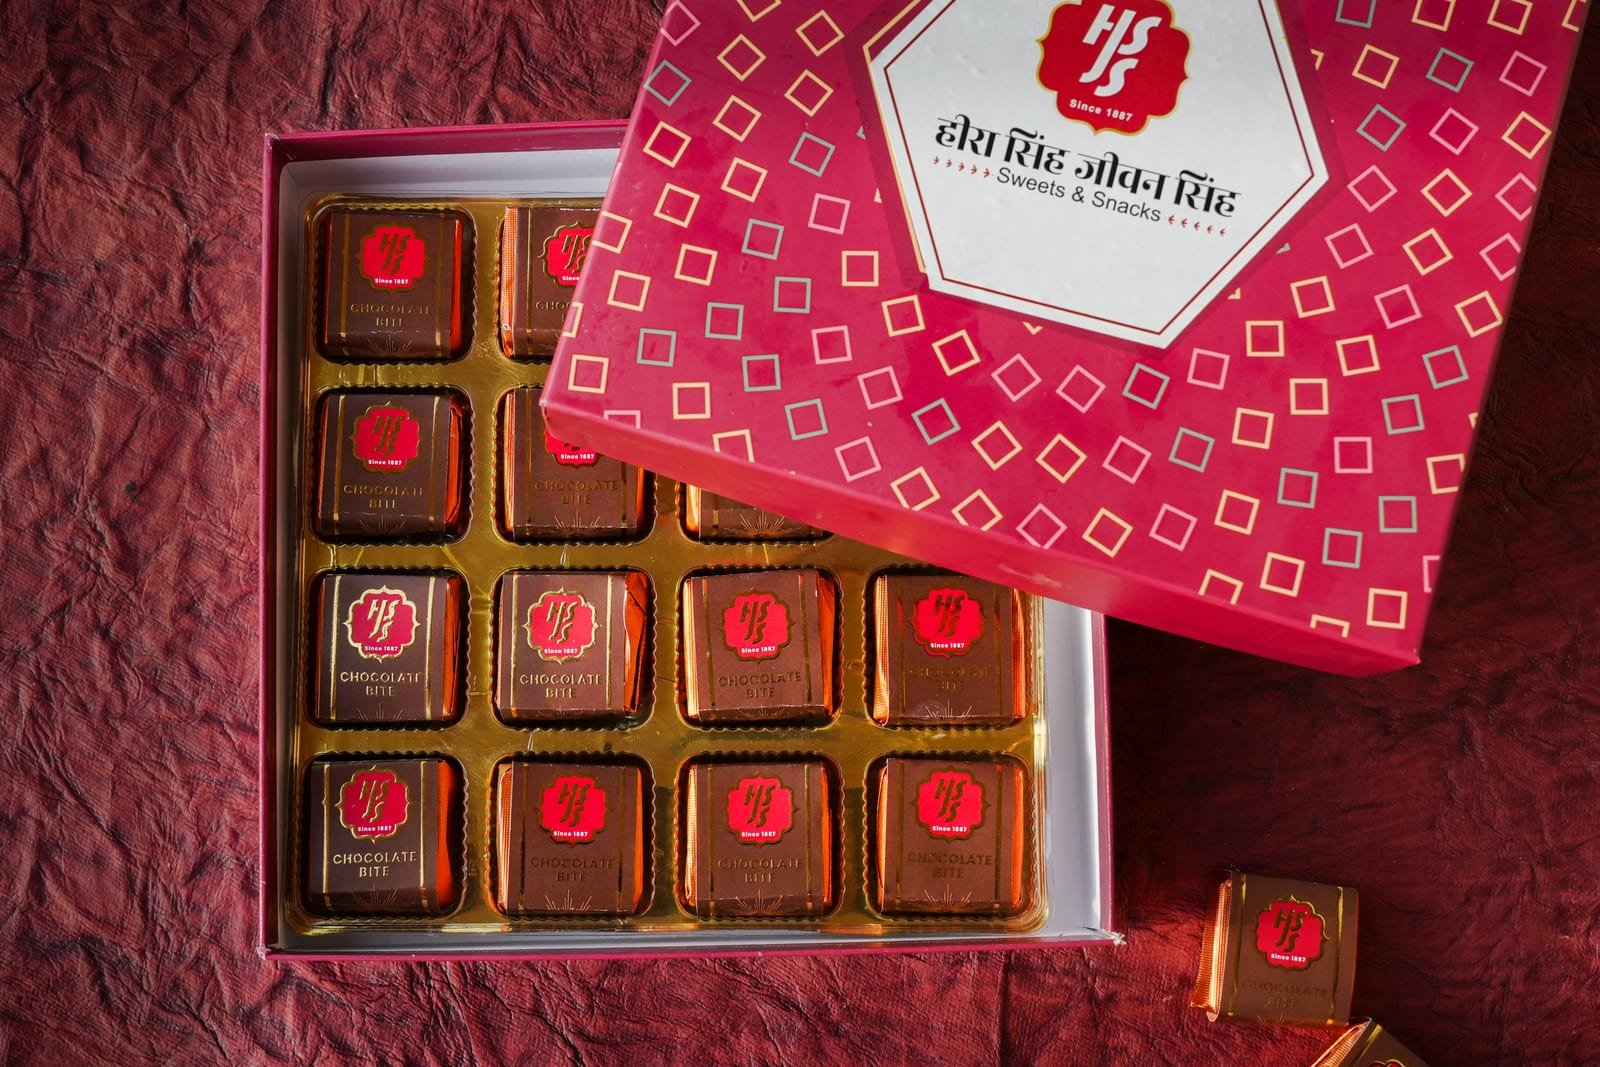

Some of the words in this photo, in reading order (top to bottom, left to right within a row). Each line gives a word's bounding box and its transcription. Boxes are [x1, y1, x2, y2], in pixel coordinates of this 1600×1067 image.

[1069, 98, 1102, 114] Since
[1106, 107, 1134, 122] 1887
[935, 114, 1000, 157] हीरा
[1003, 127, 1070, 175] सिंह
[1074, 151, 1171, 200] जीवन
[1174, 169, 1242, 218] सिंह
[997, 167, 1066, 198] Sweets
[1071, 186, 1086, 203] &
[1092, 191, 1161, 222] Snacks
[332, 851, 417, 865] CHOCOLATE
[359, 866, 390, 878] BITE
